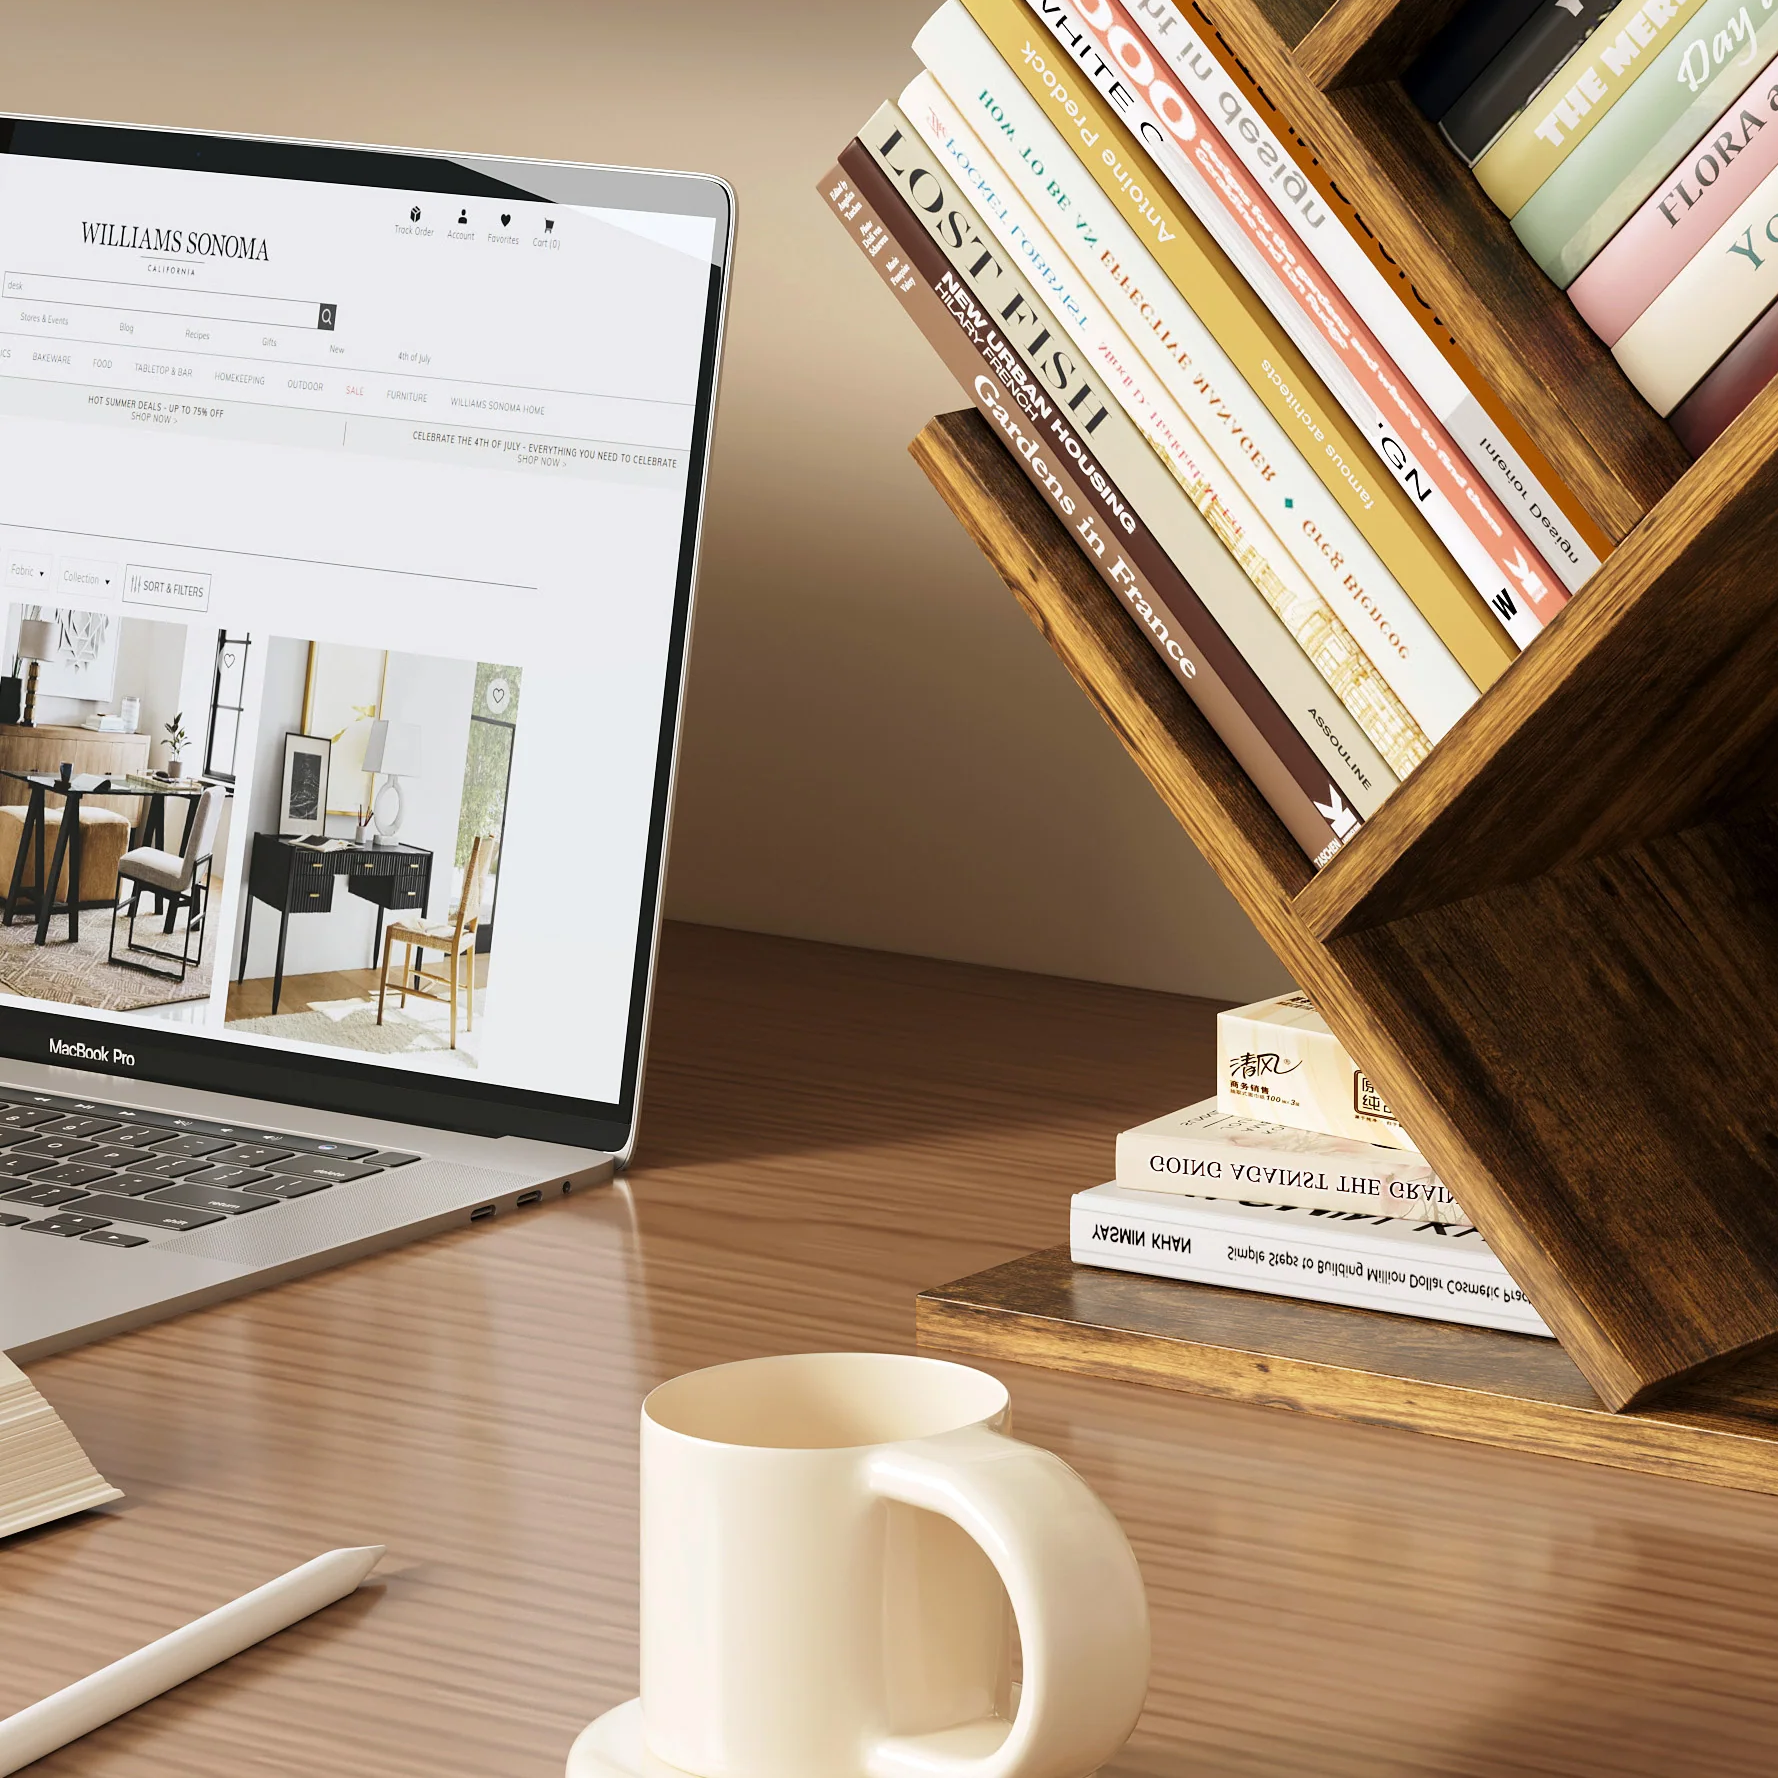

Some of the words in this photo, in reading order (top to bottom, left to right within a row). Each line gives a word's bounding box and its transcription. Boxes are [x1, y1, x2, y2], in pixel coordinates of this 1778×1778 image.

[1677, 6, 1756, 91] Day
[1020, 40, 1099, 147] Predock
[1533, 65, 1608, 146] THE
[1657, 110, 1767, 228] FLORA
[1101, 148, 1176, 242] Antoine
[81, 220, 185, 254] WILLIAMS
[186, 231, 269, 262] SONOMA
[446, 229, 475, 241] Account
[486, 232, 520, 246] Favorites
[146, 263, 196, 276] CALIFORNIA
[879, 129, 1002, 278] LOST
[1000, 292, 1108, 434] FISH
[118, 322, 135, 335] Blog
[32, 352, 72, 365] BAKEWARE
[92, 358, 113, 369] FOOD
[934, 281, 984, 343] HILARY
[982, 346, 1038, 424] FRENCH
[213, 370, 266, 386] HOMEKEEPING
[286, 378, 324, 392] OUTDOOR
[345, 384, 365, 396] SALE
[385, 388, 428, 404] FURNITURE
[449, 395, 487, 410] WILLIAMS
[487, 400, 521, 414] SONOMA
[522, 403, 546, 416] HOME
[937, 270, 988, 337] NEW
[977, 330, 1052, 419] URBAN
[1050, 418, 1136, 534] HOUSING
[1261, 359, 1324, 441] architects
[130, 411, 152, 422] SHOP
[152, 413, 172, 424] NOW
[411, 430, 455, 444] CELEBRATE
[456, 435, 473, 446] THE
[473, 437, 490, 448] 4TH
[490, 439, 502, 450] OF
[502, 440, 521, 454] JULY
[527, 442, 577, 458] EVERYTHING
[578, 448, 596, 460] YOU
[596, 450, 619, 462] NEED
[620, 453, 631, 463] TO
[632, 454, 677, 469] CELEBRATE
[1325, 443, 1374, 509] famous
[974, 374, 1075, 515] Gardens
[1075, 516, 1105, 559] in
[1106, 555, 1196, 679] France
[1307, 708, 1371, 790] ASSOULINE
[1312, 836, 1341, 870] TASCHEN
[49, 1037, 108, 1062] MacBook
[112, 1048, 136, 1066] Pro
[1229, 1079, 1271, 1096] 商务销售
